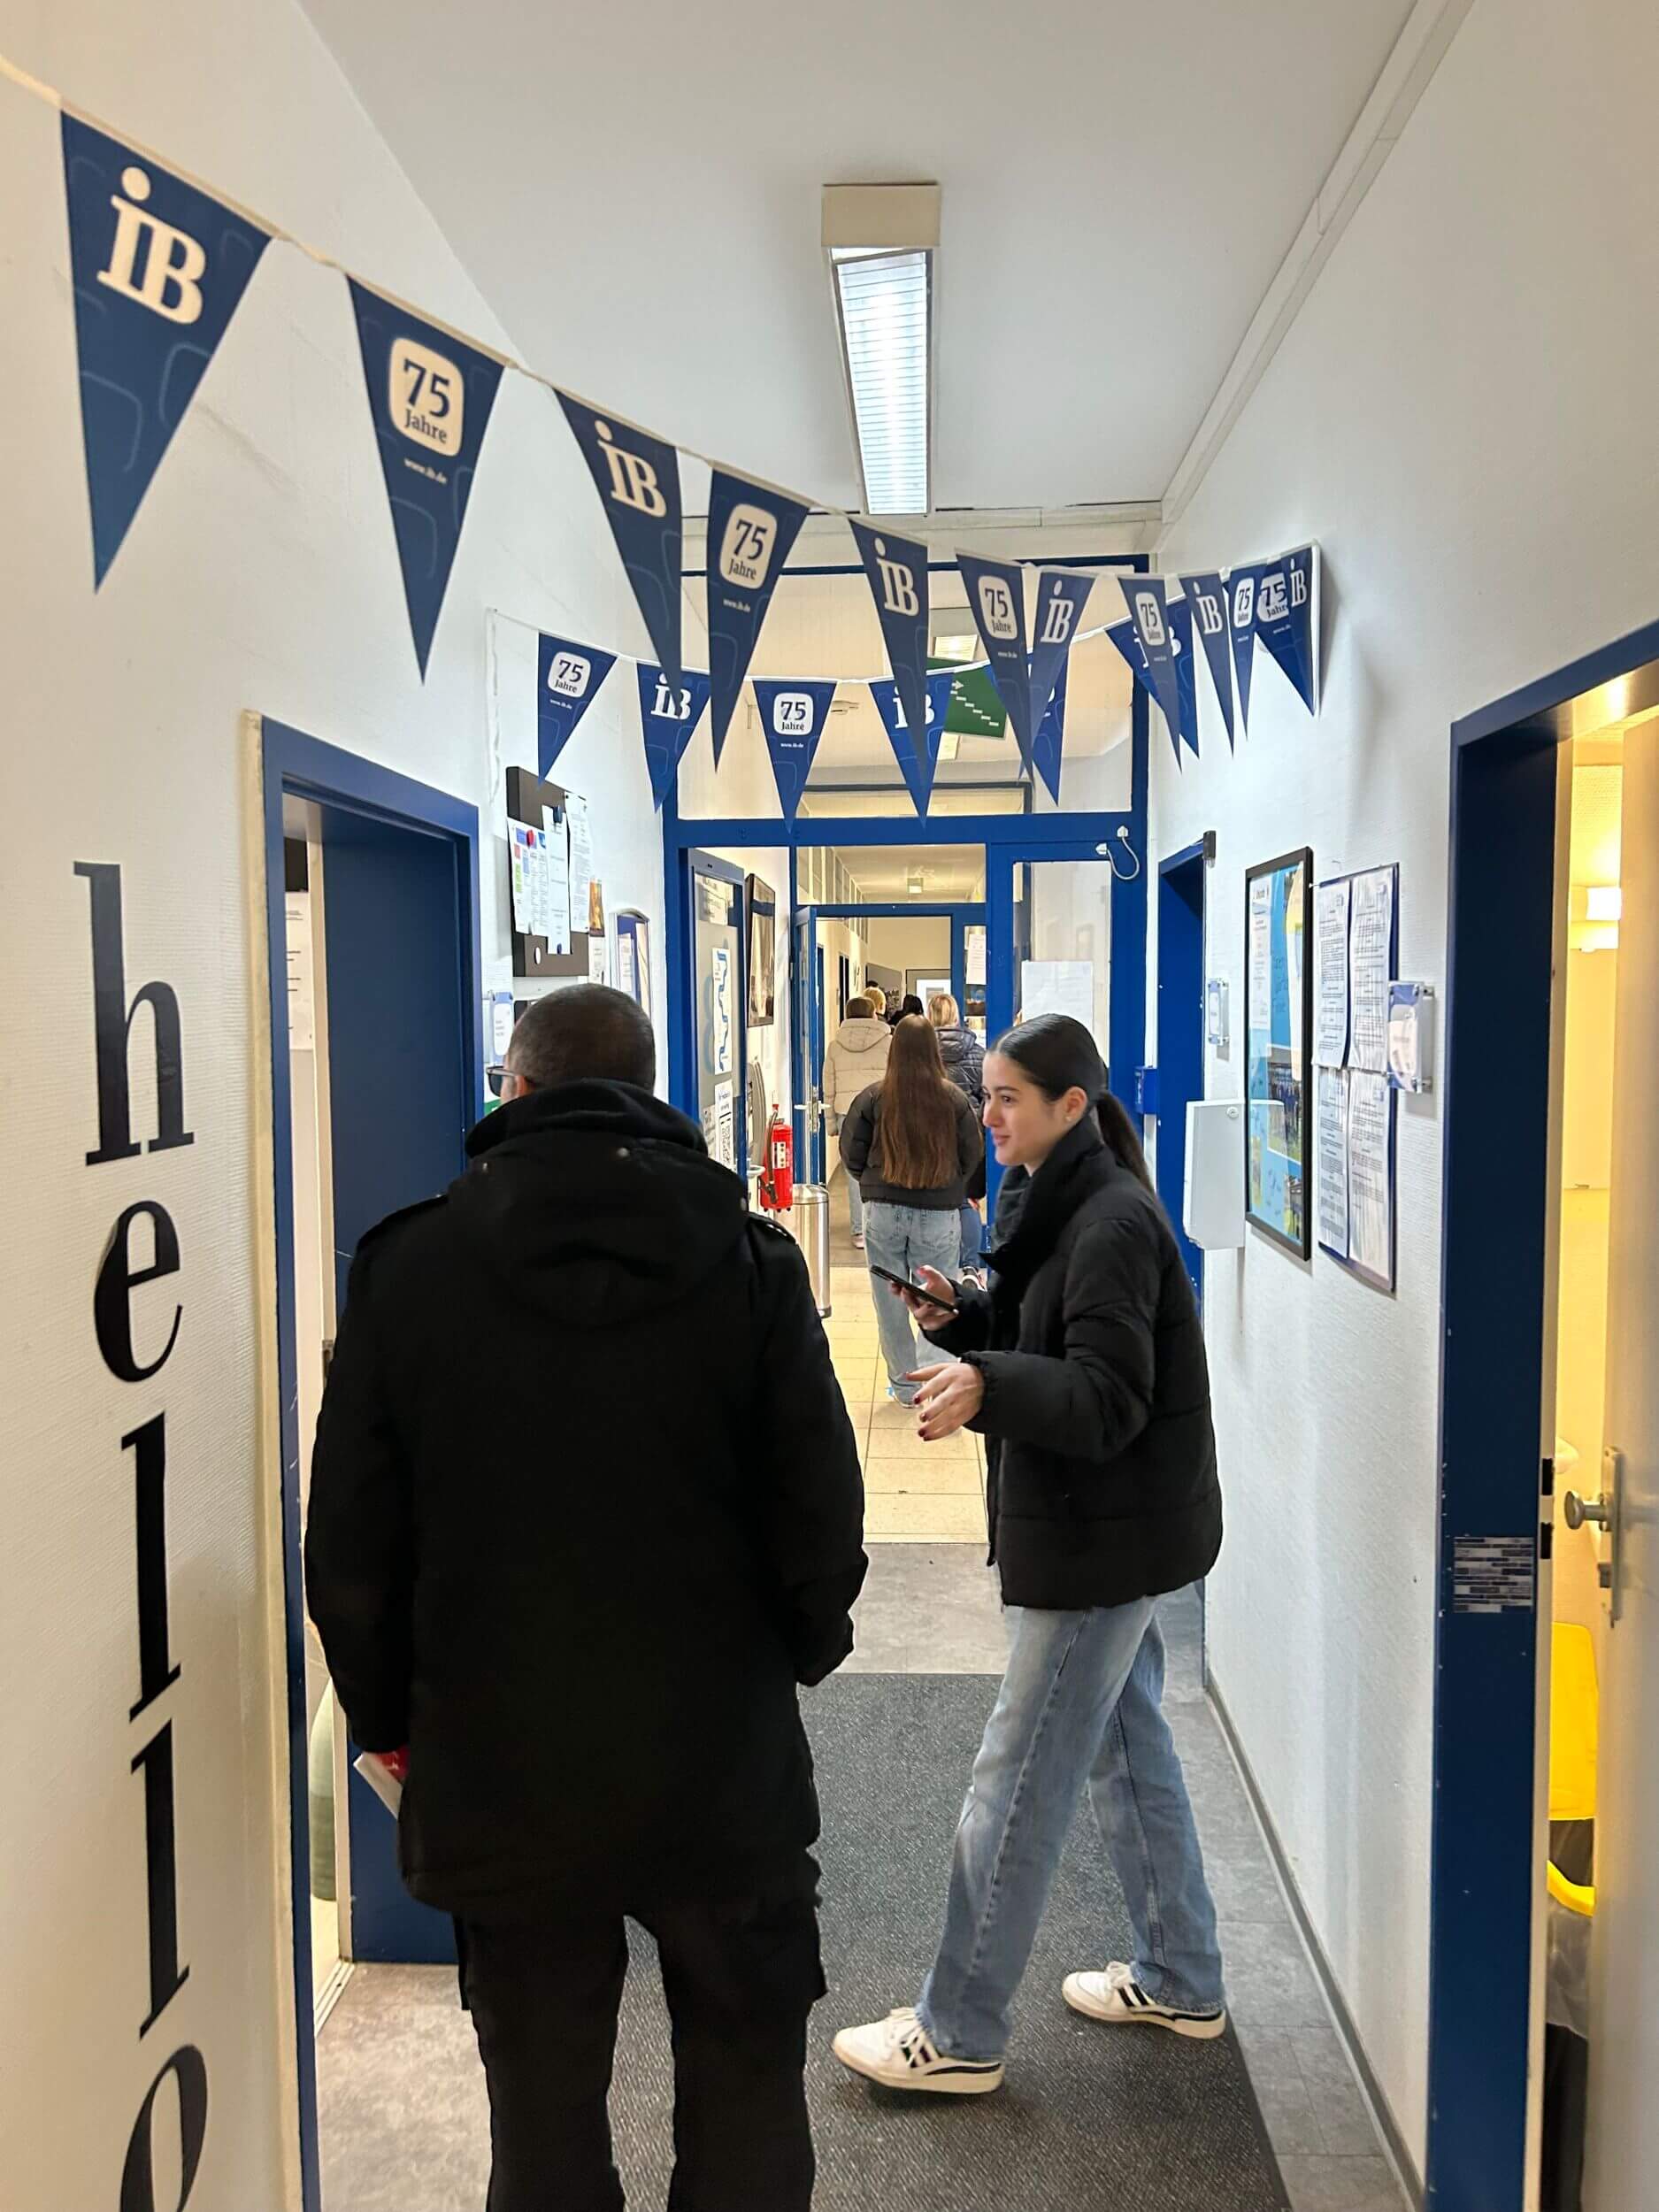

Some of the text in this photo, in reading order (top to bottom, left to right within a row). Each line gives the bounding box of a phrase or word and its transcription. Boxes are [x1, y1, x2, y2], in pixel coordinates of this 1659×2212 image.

[403, 357, 450, 419] 75
[403, 408, 449, 444] Jahre
[733, 518, 767, 560] 75
[728, 558, 757, 580] Jahre
[984, 588, 1008, 618] 75
[1238, 587, 1250, 611] 75
[1260, 580, 1286, 607] 75
[991, 619, 1012, 634] Jahre
[1140, 603, 1157, 627] 75
[558, 659, 584, 683] 75
[554, 679, 578, 694] Jahre
[780, 701, 806, 721] 75
[780, 721, 805, 732] Jahre
